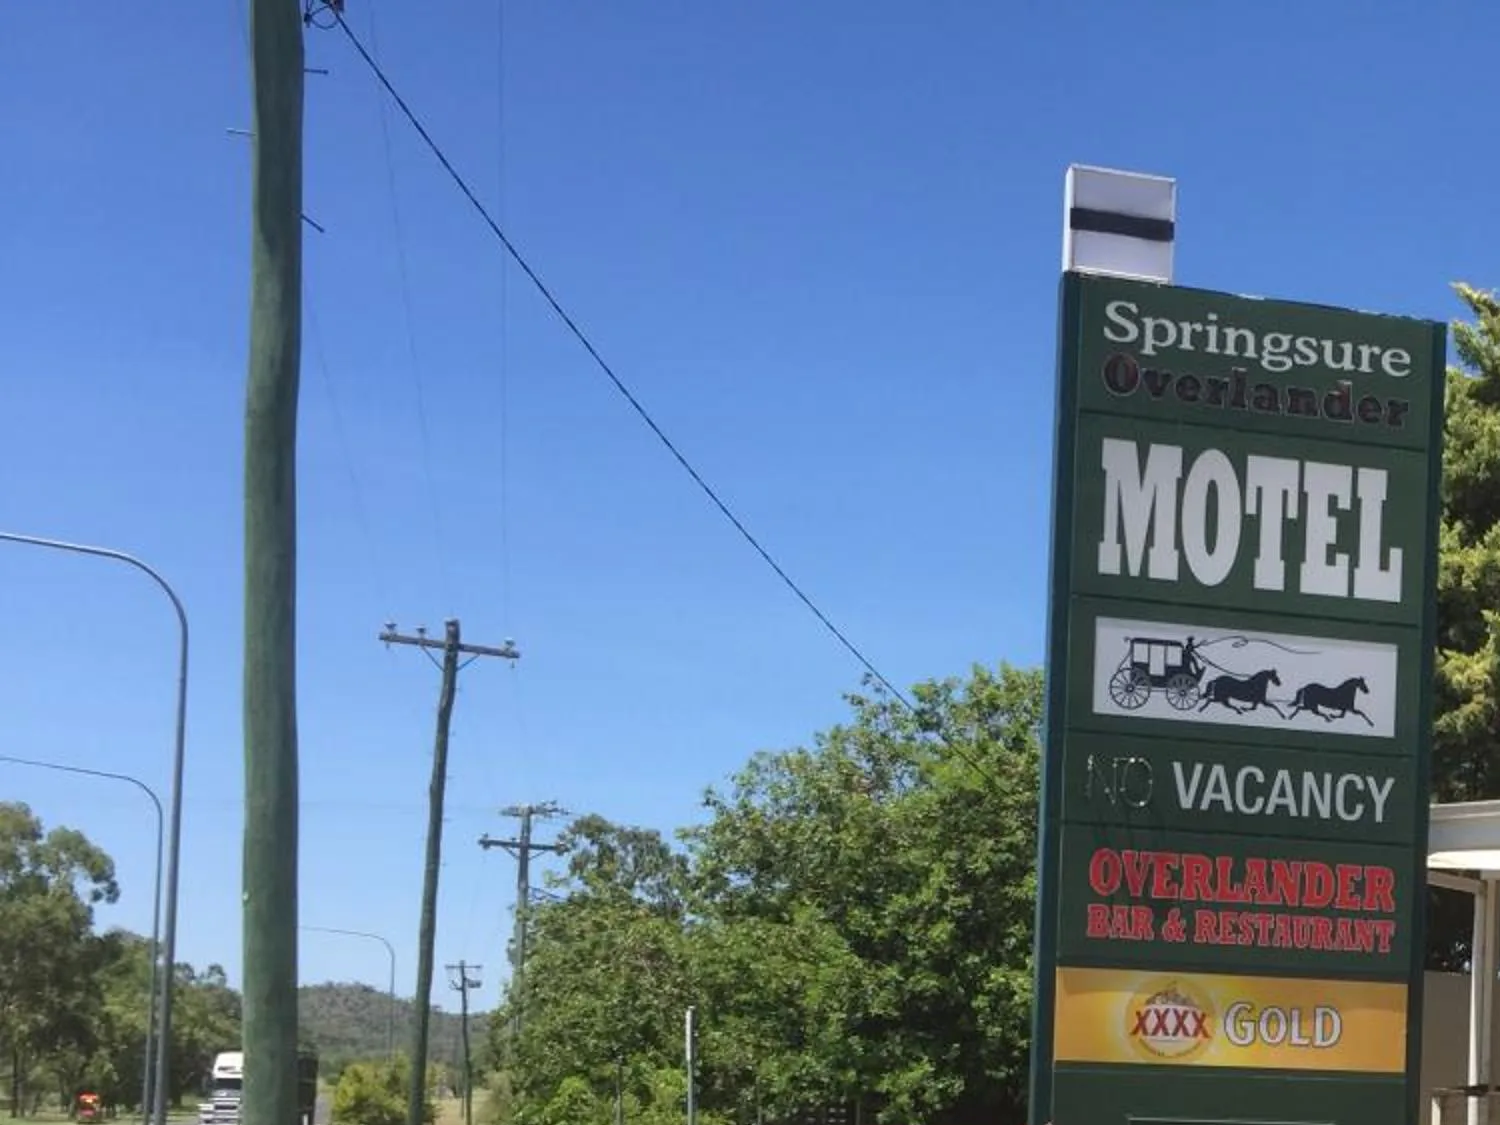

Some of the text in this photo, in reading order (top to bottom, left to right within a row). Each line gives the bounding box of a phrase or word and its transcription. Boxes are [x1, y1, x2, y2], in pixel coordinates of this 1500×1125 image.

[1104, 301, 1411, 377] Springsure
[1103, 352, 1409, 427] Overlander
[1098, 437, 1403, 603] MOTEL
[1173, 761, 1395, 823] VACANCY
[1088, 847, 1395, 912] OVERLANDER
[1086, 903, 1395, 952] BAR & RESTAURANT
[1129, 1001, 1342, 1048] XXXX GOLD
